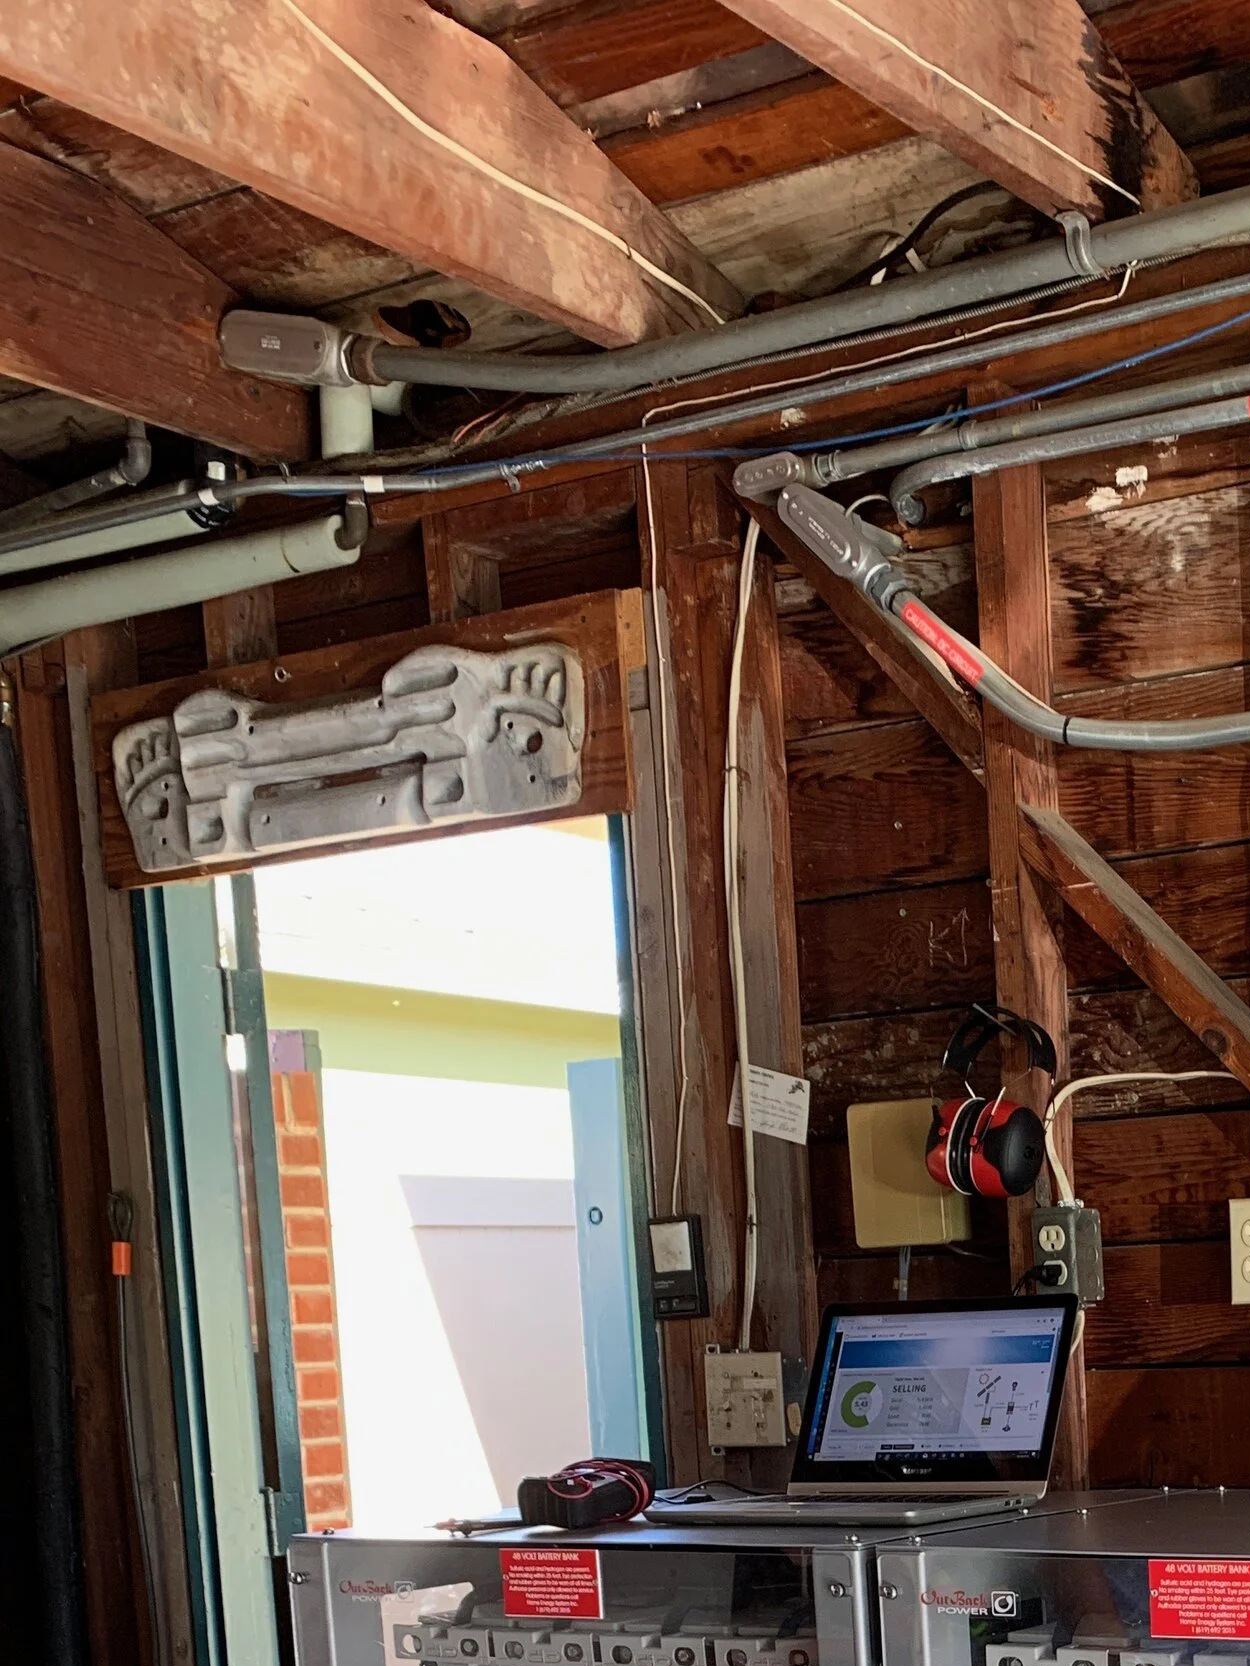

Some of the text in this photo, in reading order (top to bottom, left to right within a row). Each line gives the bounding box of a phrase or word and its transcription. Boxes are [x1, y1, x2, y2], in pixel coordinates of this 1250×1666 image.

[892, 1384, 927, 1393] SELLING
[1165, 1564, 1250, 1574] 48 VOLT BATTERY BANK
[921, 1590, 989, 1606] OutBack
[937, 1606, 989, 1616] POWER
